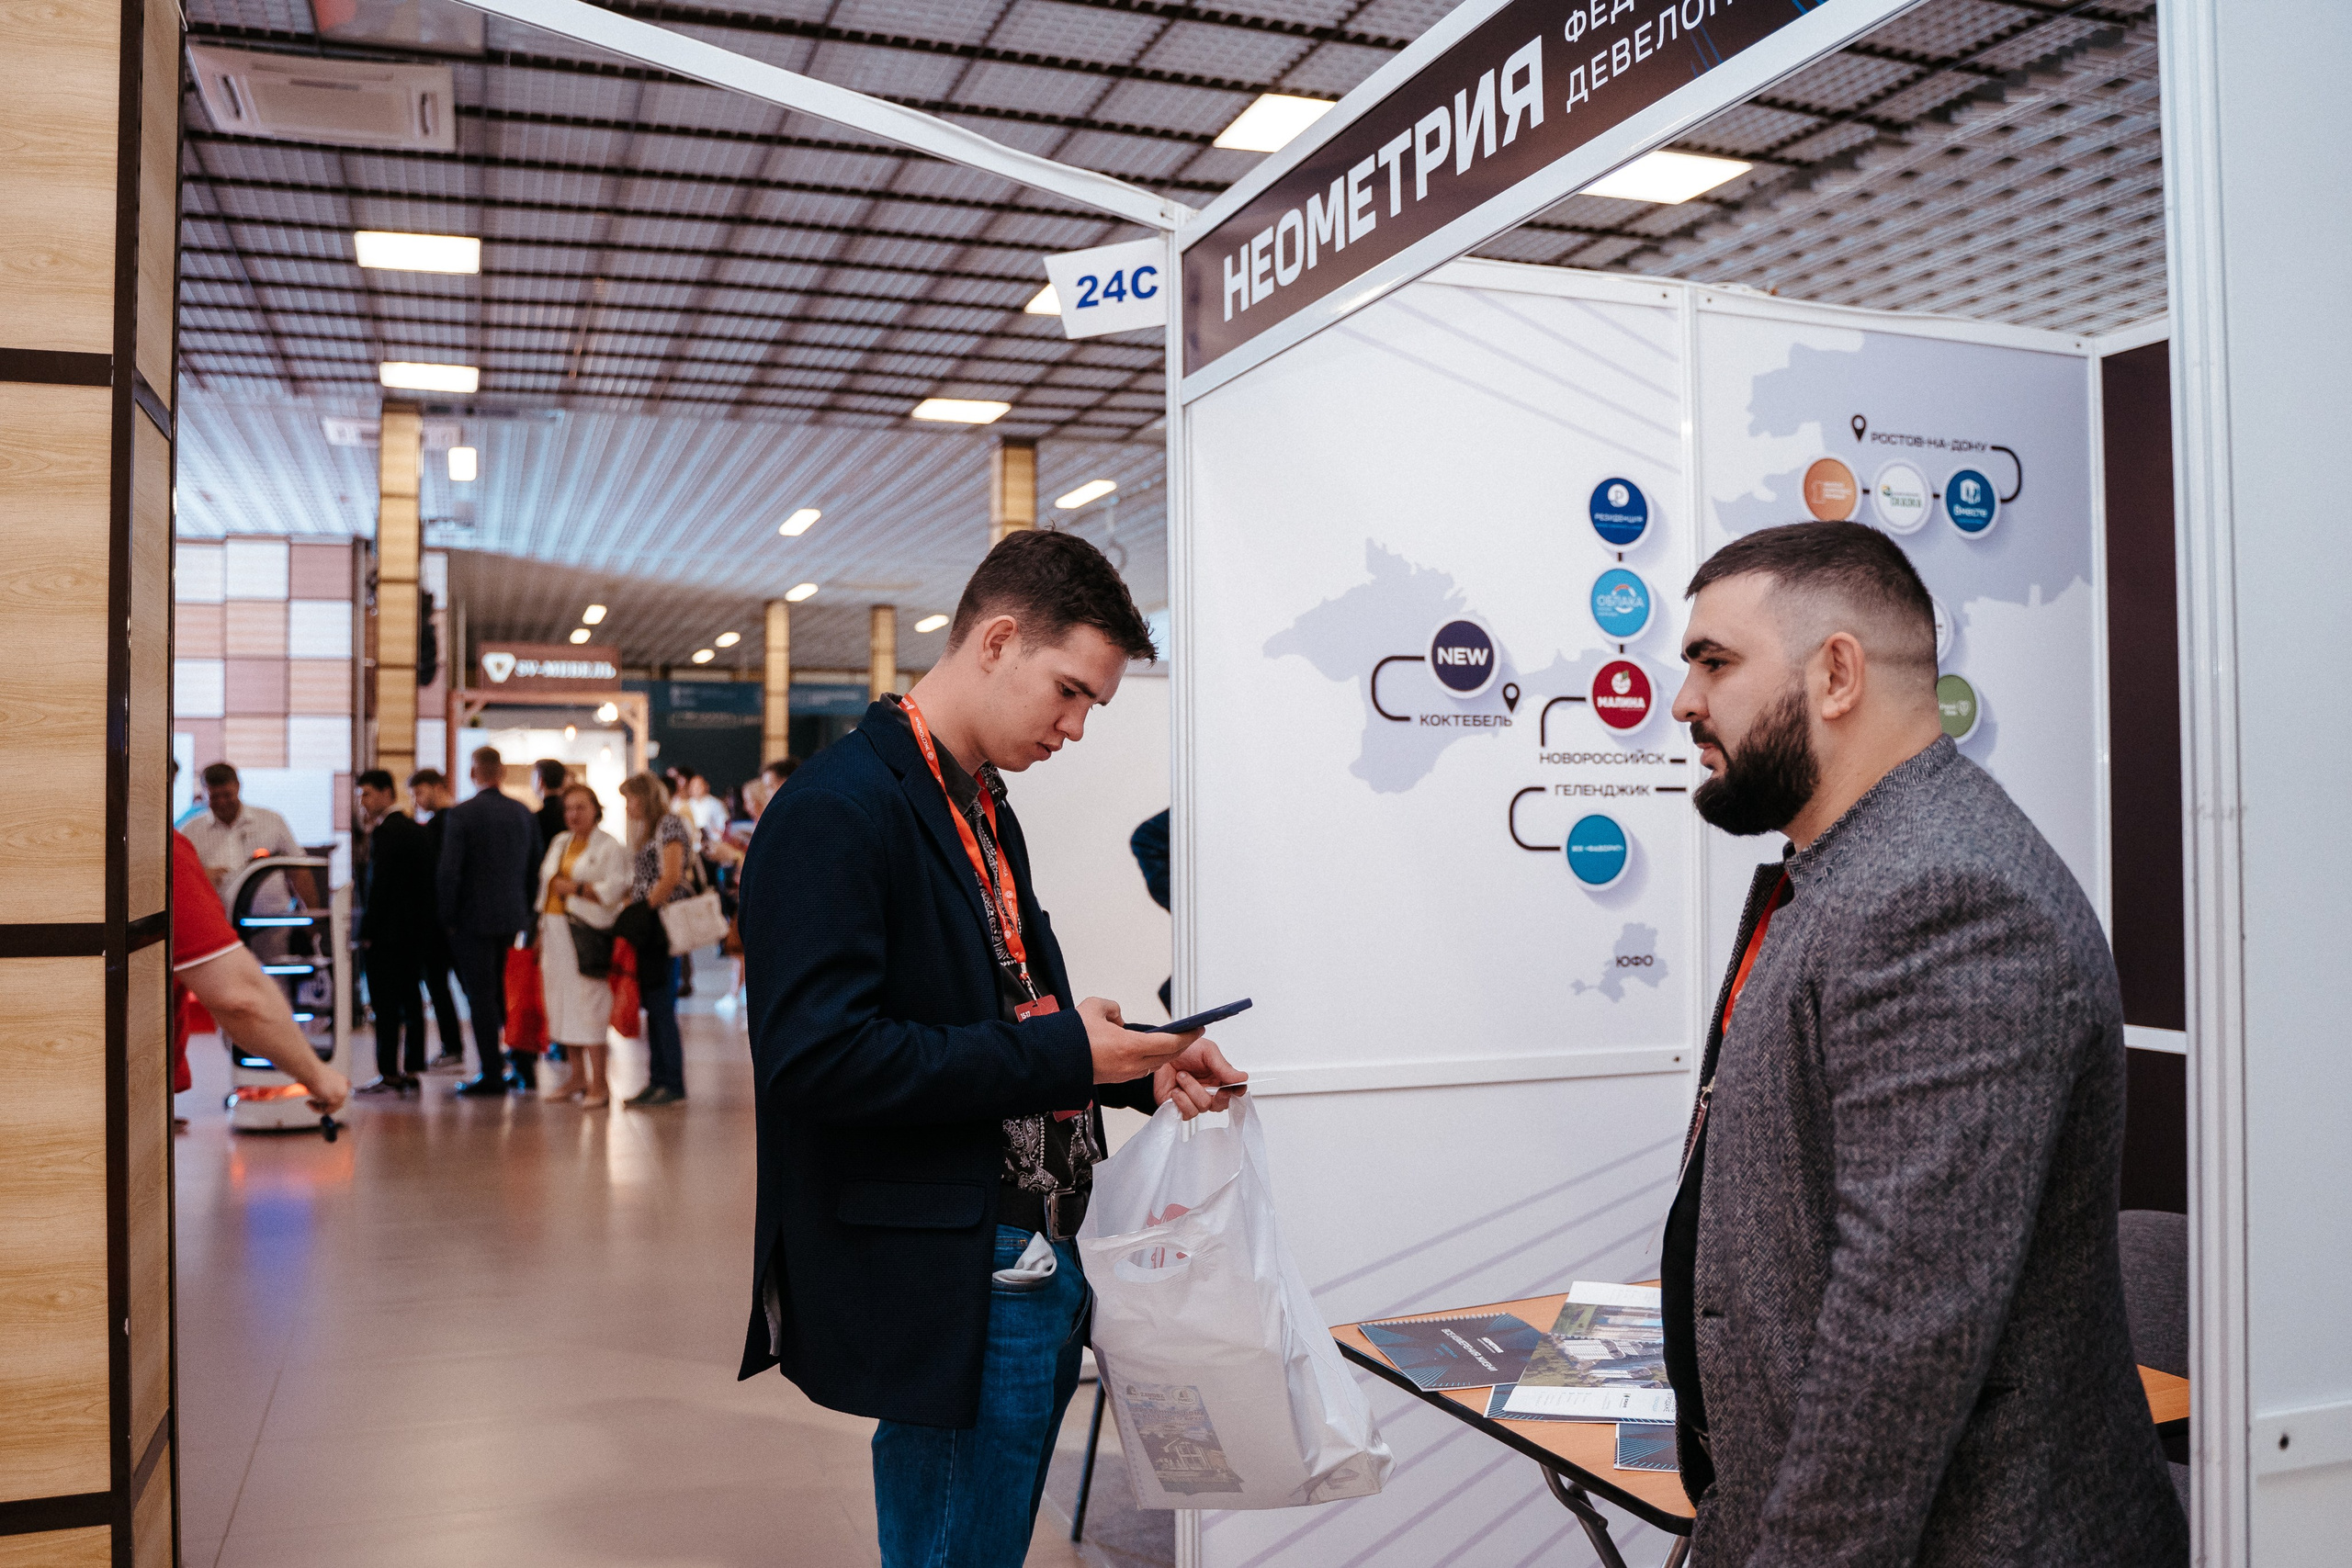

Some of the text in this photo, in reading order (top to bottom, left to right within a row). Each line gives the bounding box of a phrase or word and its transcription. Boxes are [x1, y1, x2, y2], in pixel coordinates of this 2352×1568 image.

[1224, 35, 1544, 322] НЕОМЕТРИЯ
[1871, 432, 1986, 451] РОСТОВ-НА-ДОНУ
[1437, 647, 1488, 666] NEW
[1419, 715, 1513, 727] КОКТЕБЕЛЬ
[1540, 750, 1666, 764] НОВОРОССИЙСК
[1555, 784, 1650, 798] ГЕЛЕНДЖИК
[1616, 955, 1653, 967] ЮФО
